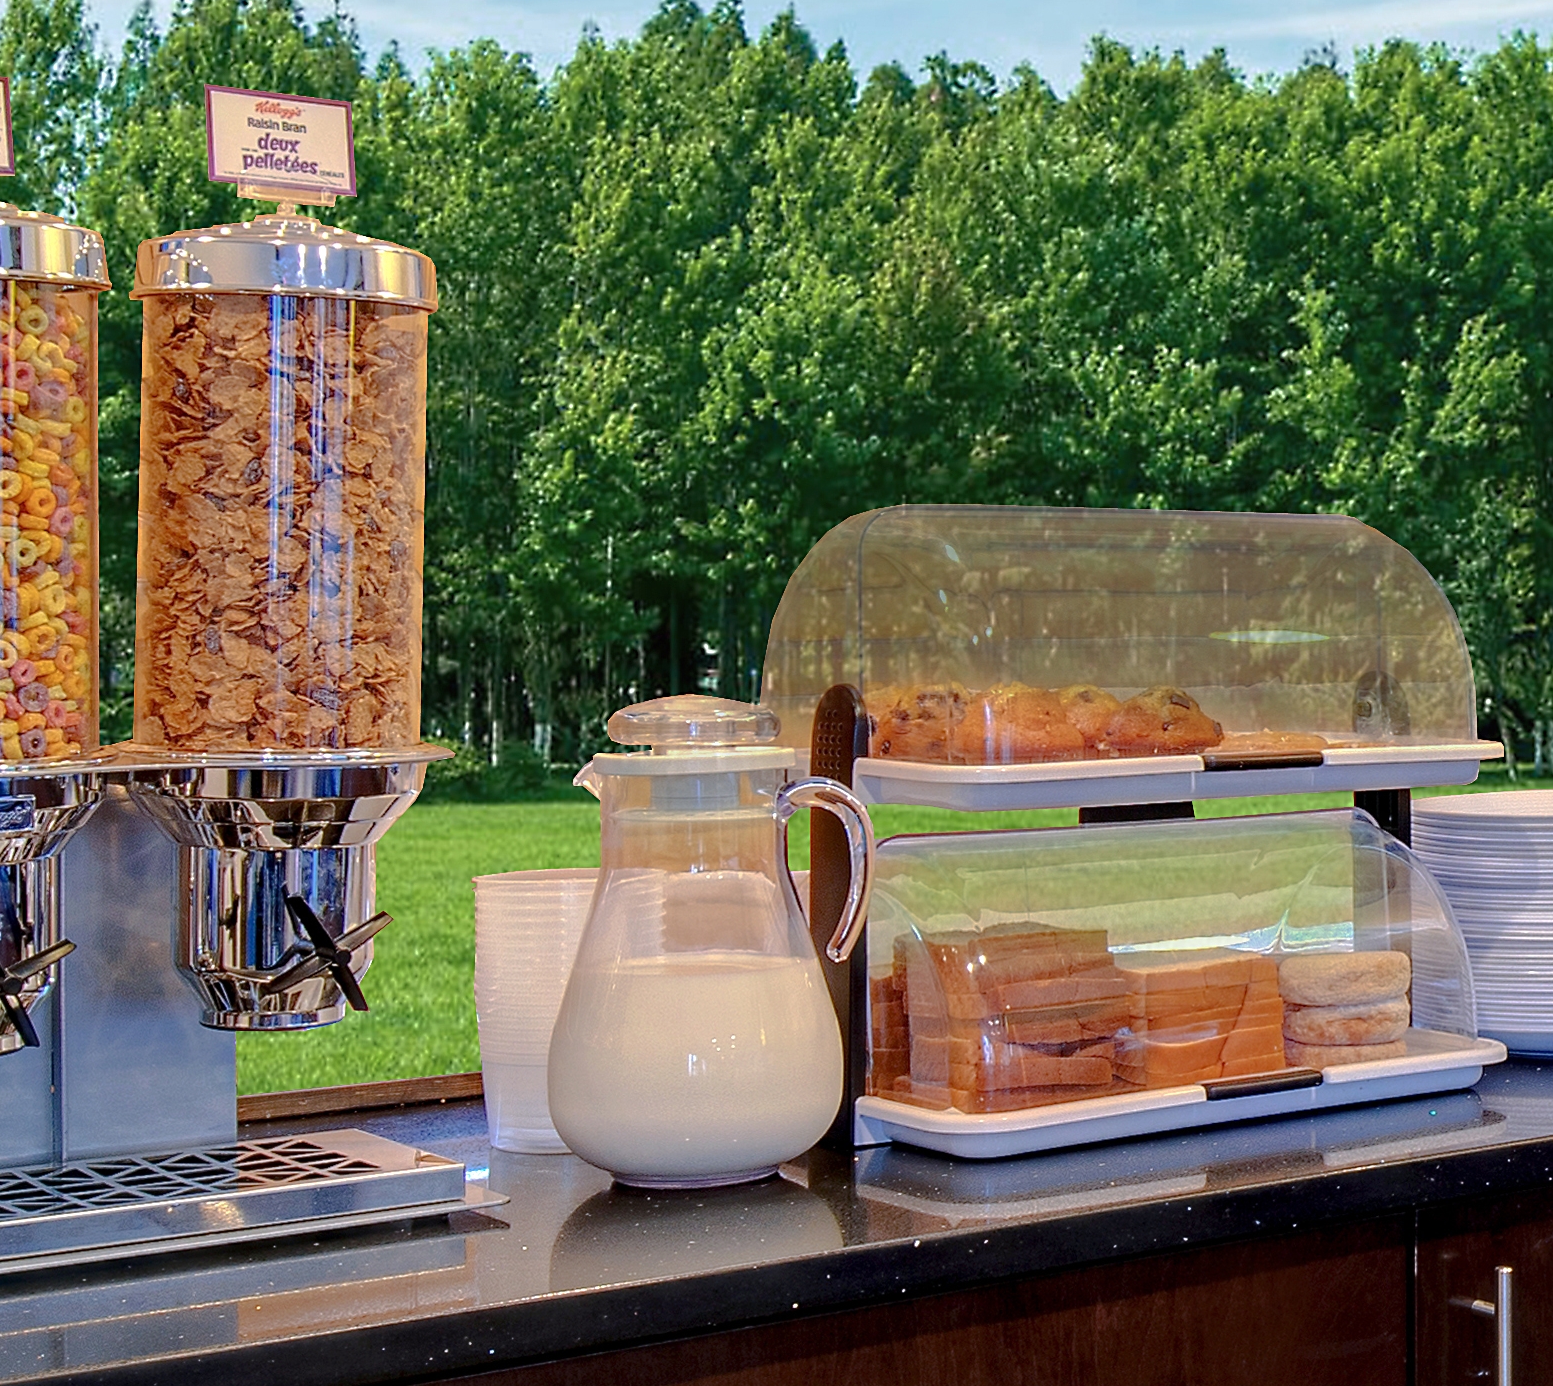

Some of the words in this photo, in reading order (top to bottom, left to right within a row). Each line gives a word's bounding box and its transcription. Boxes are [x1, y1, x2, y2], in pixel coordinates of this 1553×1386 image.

[255, 100, 302, 119] Kellogg's
[247, 117, 280, 131] Raisin
[282, 121, 307, 133] Bran
[258, 133, 301, 153] deux
[242, 153, 318, 175] pelletées
